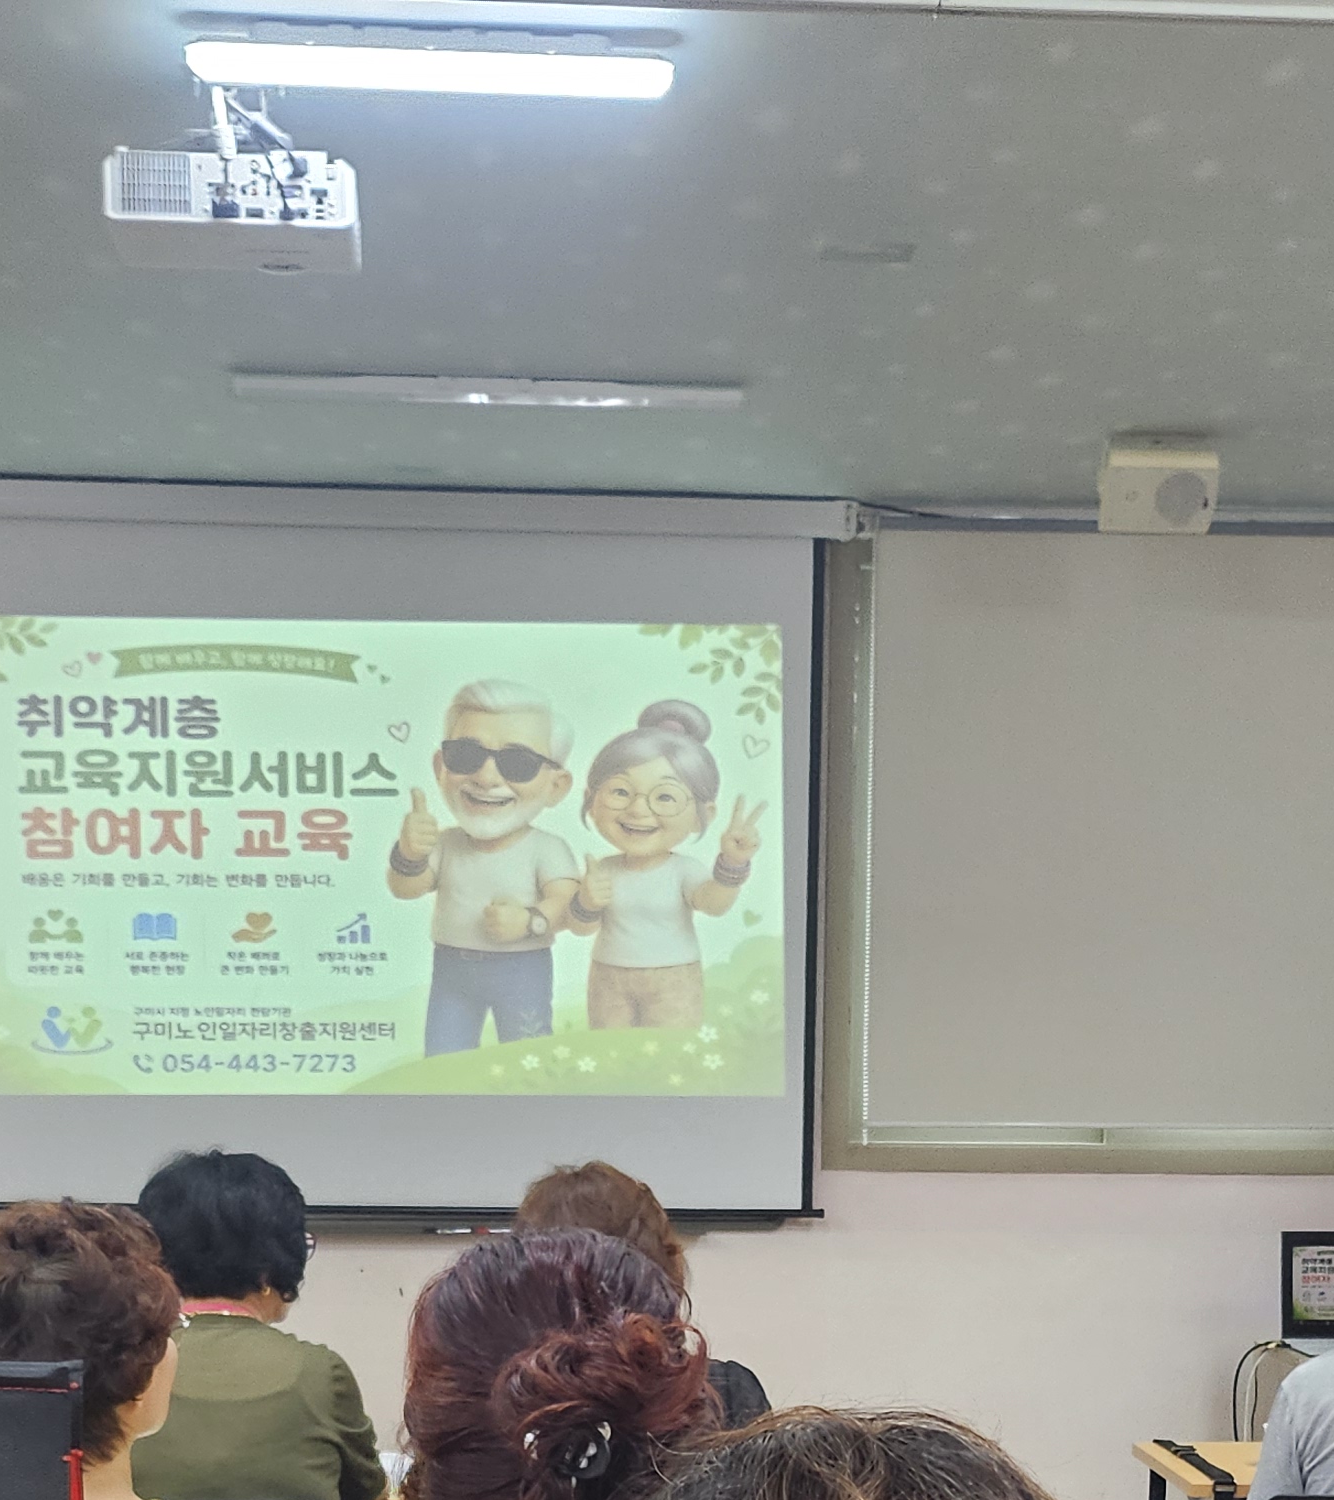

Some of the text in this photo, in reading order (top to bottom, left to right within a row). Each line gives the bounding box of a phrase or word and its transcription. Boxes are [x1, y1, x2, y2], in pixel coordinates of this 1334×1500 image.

[17, 694, 221, 740] 취약계층
[18, 749, 399, 798] 교육지원서비스
[21, 807, 353, 861] 참여자 교육
[21, 873, 336, 888] 배움은 기회를 만들고, 기회는 변화를 만듭니다.
[132, 1021, 396, 1041] 구미노인일자리창출지원센터
[162, 1054, 357, 1073] 054-443-7273
